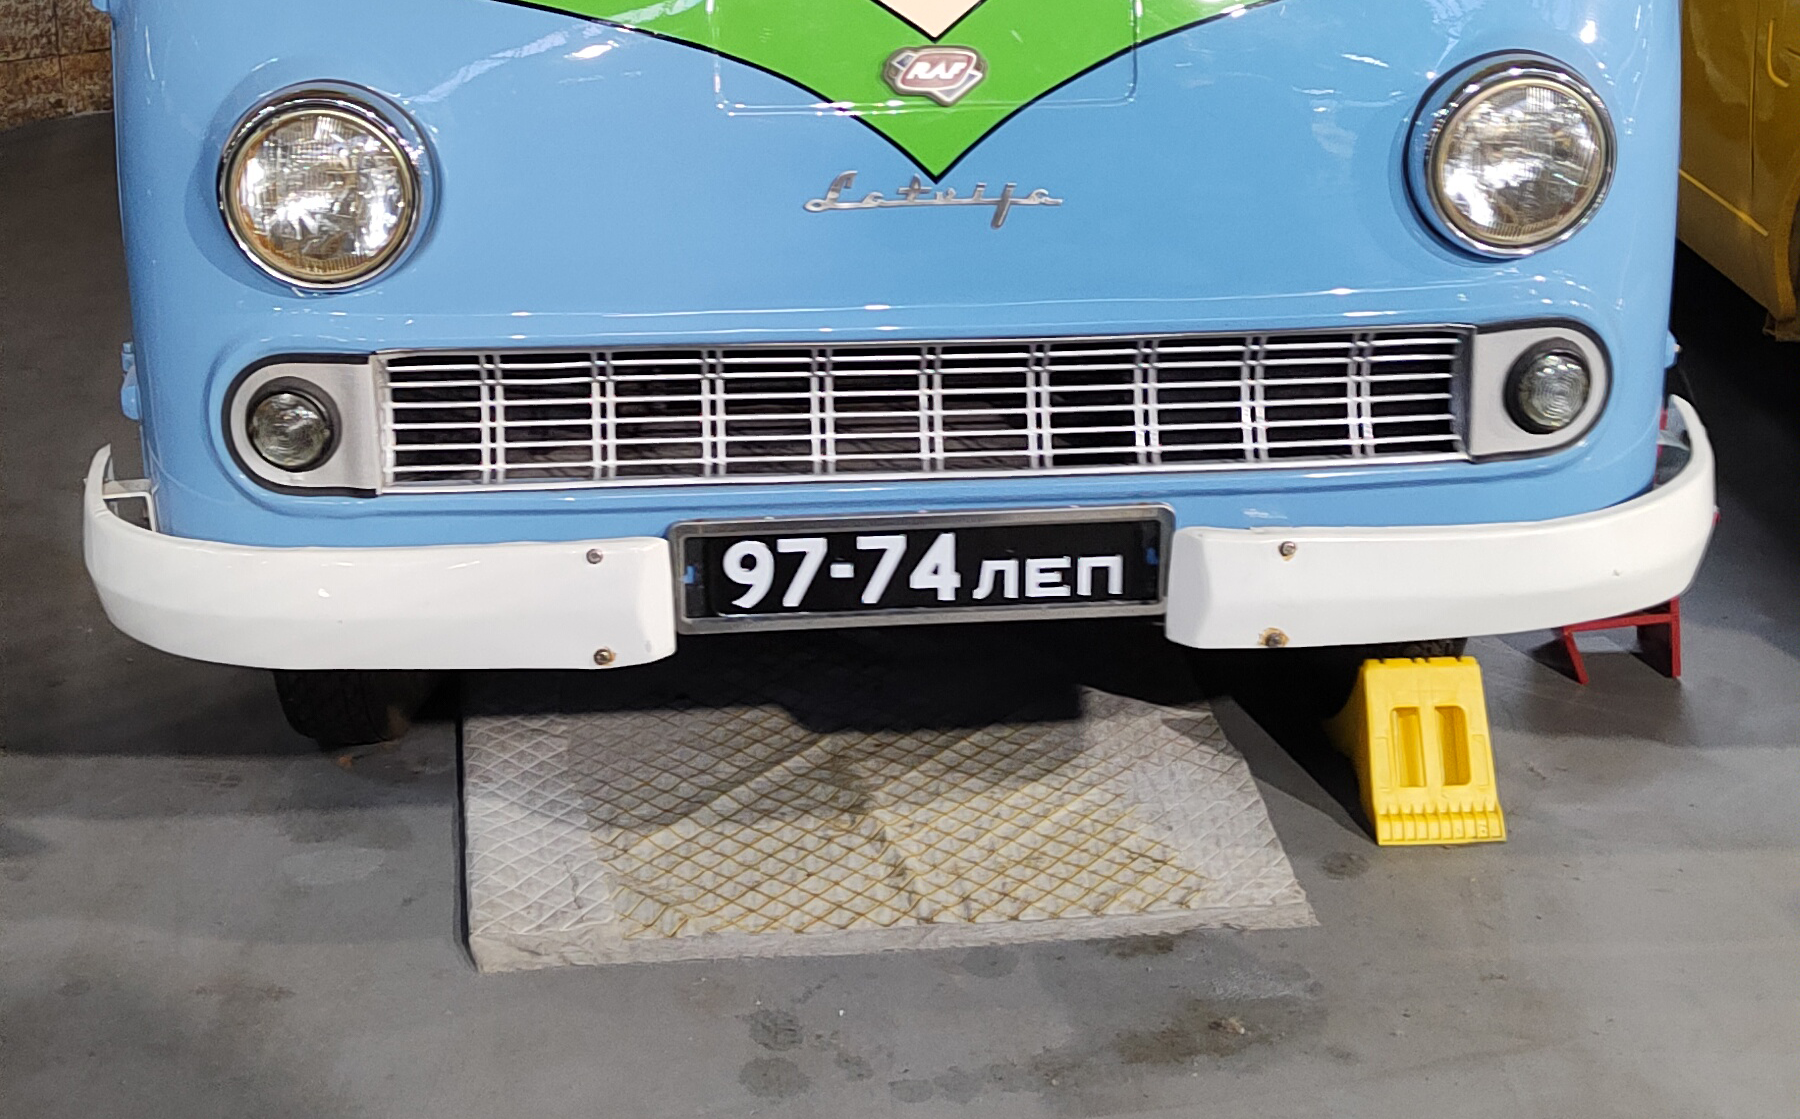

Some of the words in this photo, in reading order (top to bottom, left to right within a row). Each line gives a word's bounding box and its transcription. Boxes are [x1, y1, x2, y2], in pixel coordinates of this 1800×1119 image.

[906, 60, 968, 81] RAF
[722, 532, 961, 609] 97-74
[972, 555, 1124, 600] ЛЕП
